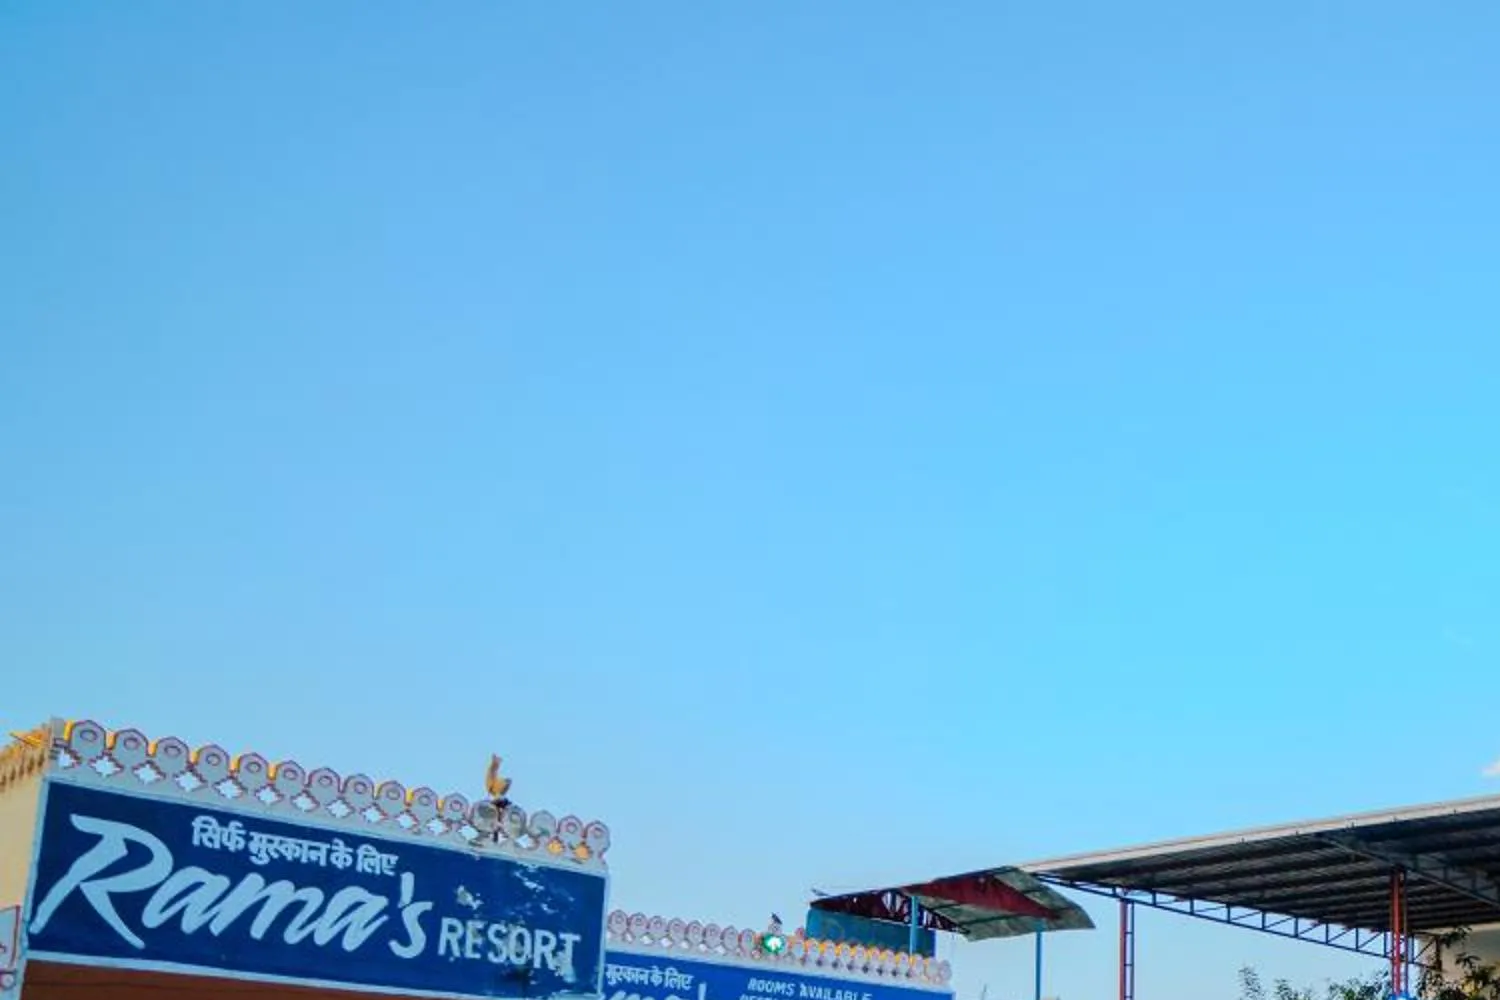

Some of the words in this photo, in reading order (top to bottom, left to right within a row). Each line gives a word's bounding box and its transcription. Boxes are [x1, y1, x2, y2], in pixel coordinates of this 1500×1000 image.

[192, 815, 246, 852] सिर्फ
[248, 831, 330, 866] मुस्कान
[329, 838, 354, 870] के
[355, 844, 399, 876] लिए
[29, 813, 433, 958] Rama's
[438, 917, 581, 977] RESORT
[650, 965, 664, 987] के
[664, 967, 694, 991] लिए
[747, 977, 796, 997] ROOMS
